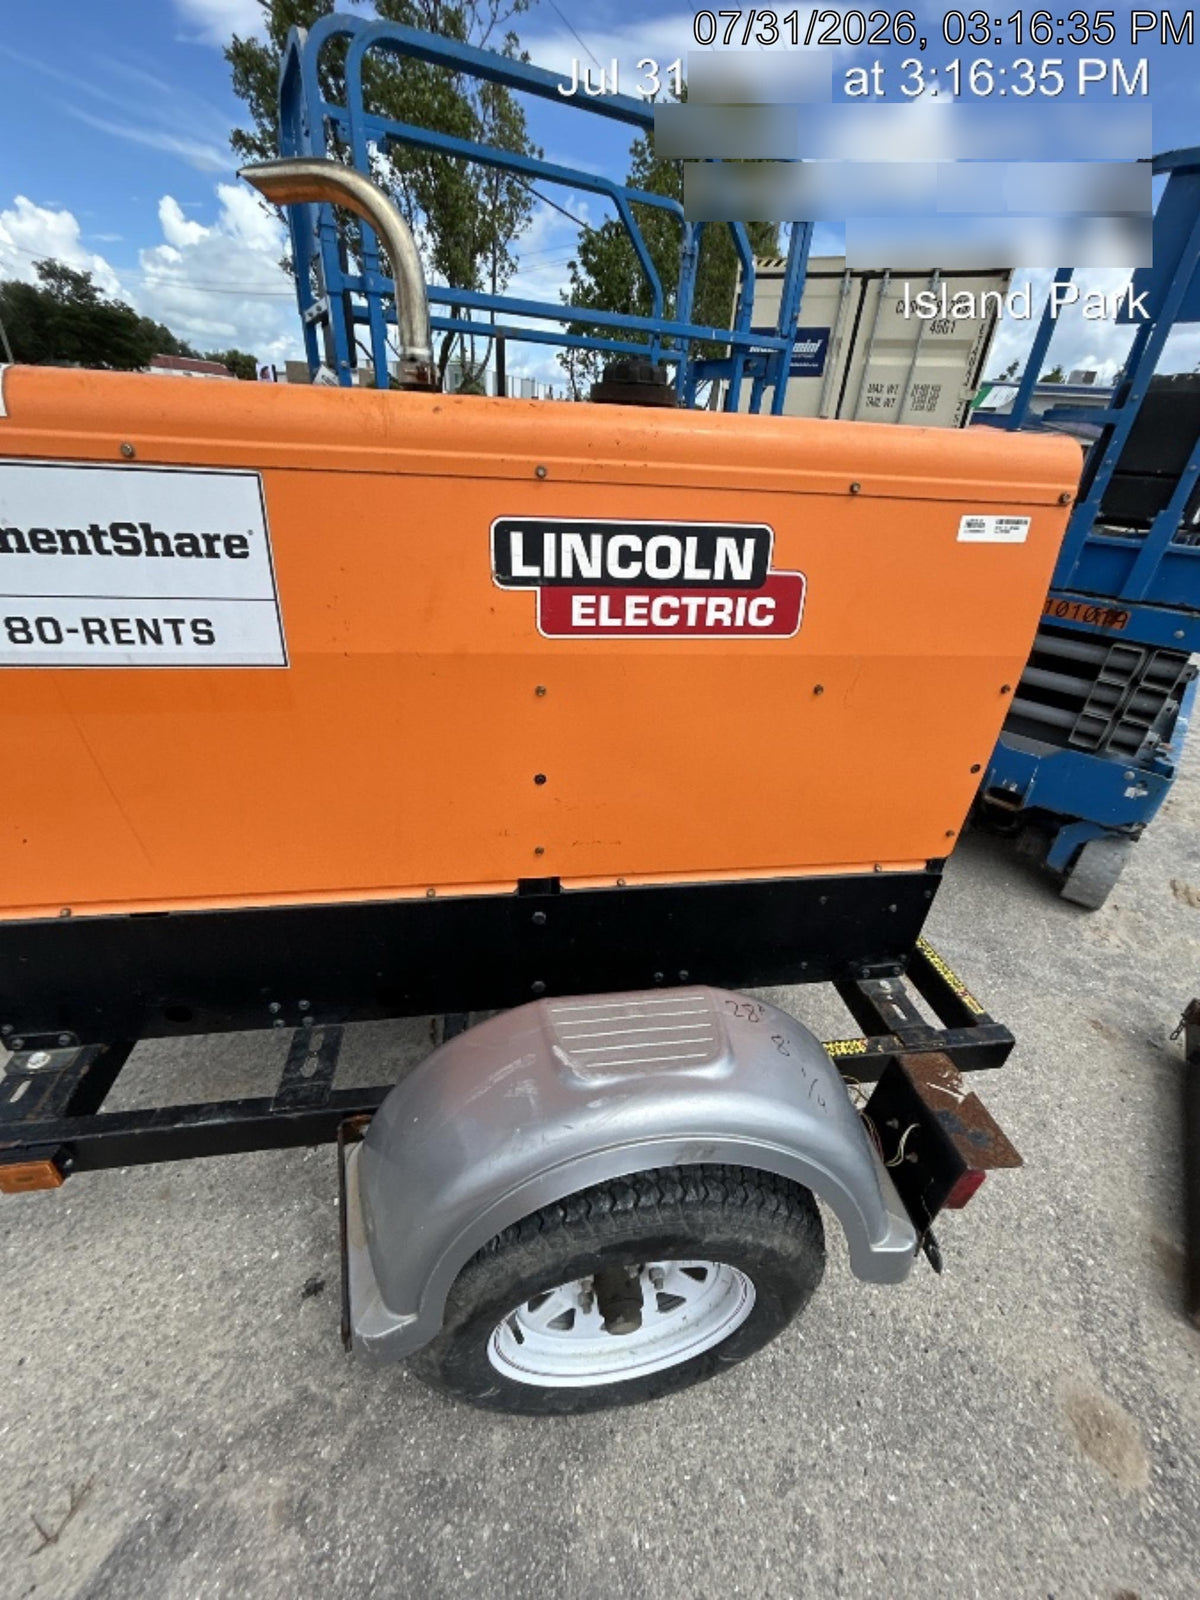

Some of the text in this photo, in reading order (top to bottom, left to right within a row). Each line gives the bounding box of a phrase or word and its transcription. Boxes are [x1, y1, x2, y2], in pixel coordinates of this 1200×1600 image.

[509, 530, 756, 580] LINCOLN
[571, 595, 776, 626] ELECTRIC
[4, 616, 216, 645] 80-RENTS
